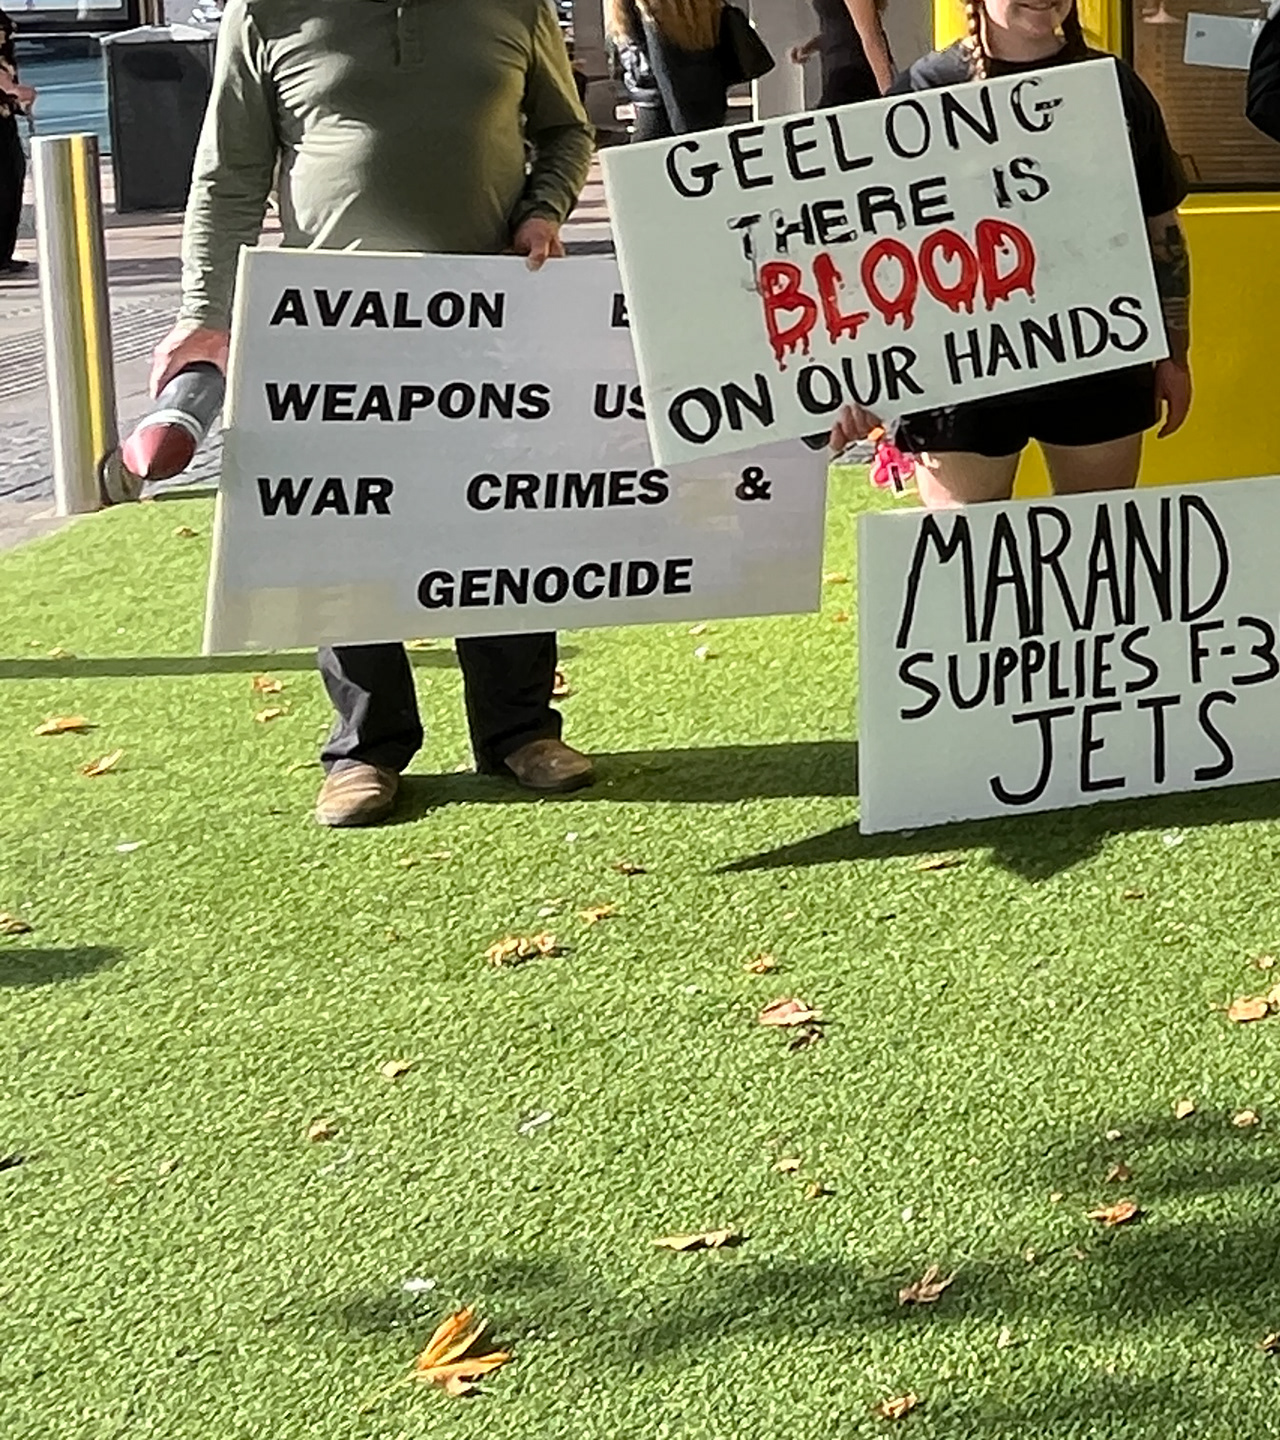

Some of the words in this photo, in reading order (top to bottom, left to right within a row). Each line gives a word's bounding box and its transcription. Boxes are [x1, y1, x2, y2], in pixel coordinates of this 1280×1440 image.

[666, 75, 1064, 198] GEELONG
[727, 176, 954, 260] THERE
[994, 157, 1051, 208] IS
[270, 289, 505, 328] AVALON
[760, 218, 1036, 368] BLOOD
[265, 382, 551, 421] WEAPONS
[667, 373, 775, 446] ON
[797, 344, 924, 417] OUR
[945, 295, 1149, 385] HANDS
[258, 477, 393, 516] WAR
[467, 469, 670, 511] CRIMES
[736, 466, 772, 502] &
[417, 558, 693, 609] GENOCIDE
[896, 494, 1230, 649] MARAND
[899, 626, 1159, 720] SUPPLIES
[989, 690, 1237, 806] JETS
